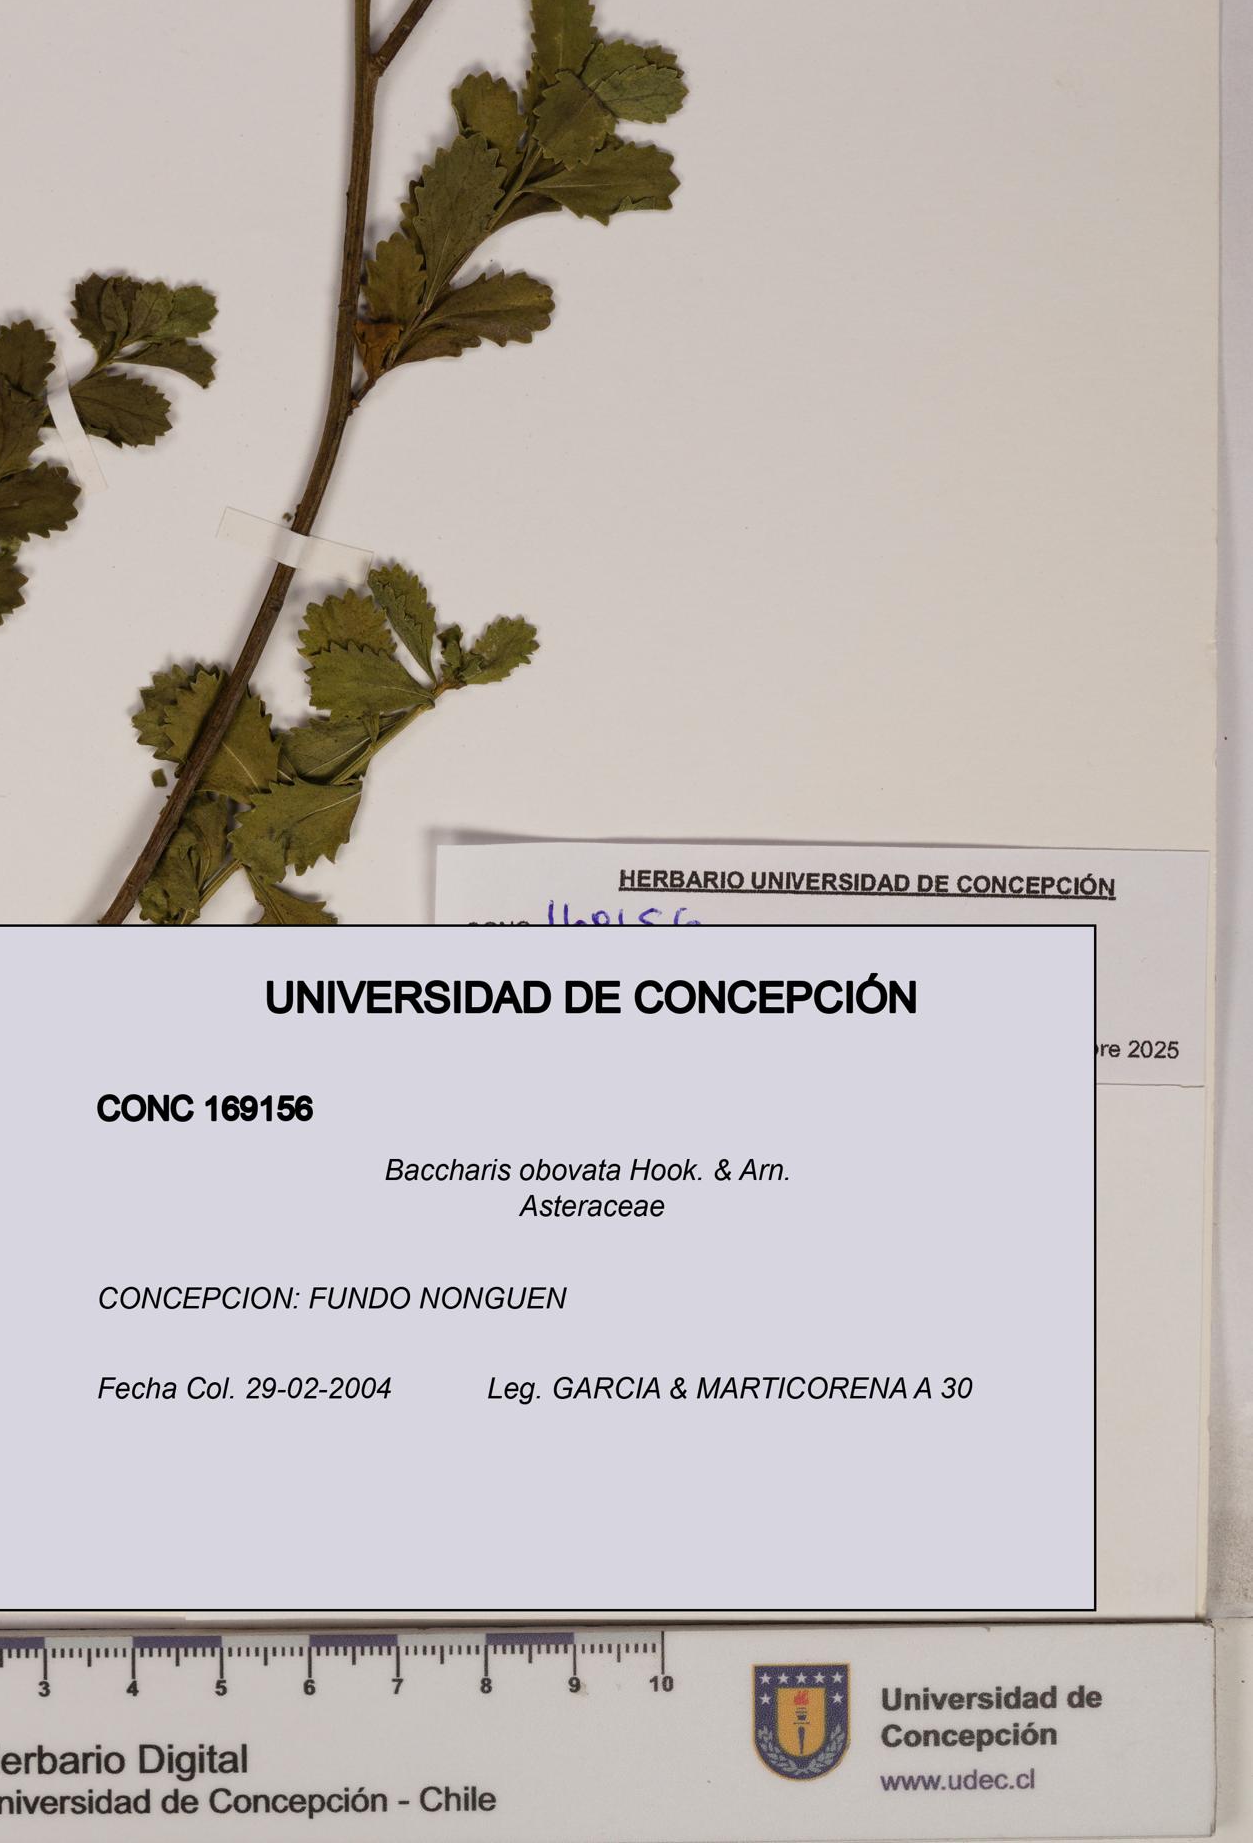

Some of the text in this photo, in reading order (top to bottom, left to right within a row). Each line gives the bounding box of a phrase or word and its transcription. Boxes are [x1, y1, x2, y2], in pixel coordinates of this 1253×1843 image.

[618, 869, 1116, 898] HERBARIO UNIVERSIDAD DE CONCEPCIÓN
[1127, 1039, 1180, 1059] 2025
[37, 1681, 52, 1697] 3
[125, 1680, 140, 1696] 4
[214, 1679, 228, 1696] 5
[302, 1678, 317, 1695] 6
[391, 1677, 404, 1694] 7
[479, 1677, 493, 1694] 8
[567, 1676, 582, 1693] 9
[649, 1675, 674, 1692] 10
[881, 1684, 1103, 1712] Universidad de
[880, 1721, 1058, 1753] Concepción
[138, 1743, 248, 1782] Digital
[879, 1767, 1035, 1792] www.udec.cl
[160, 1787, 200, 1815] de
[208, 1786, 388, 1820] Concepción
[419, 1785, 497, 1813] Chile
